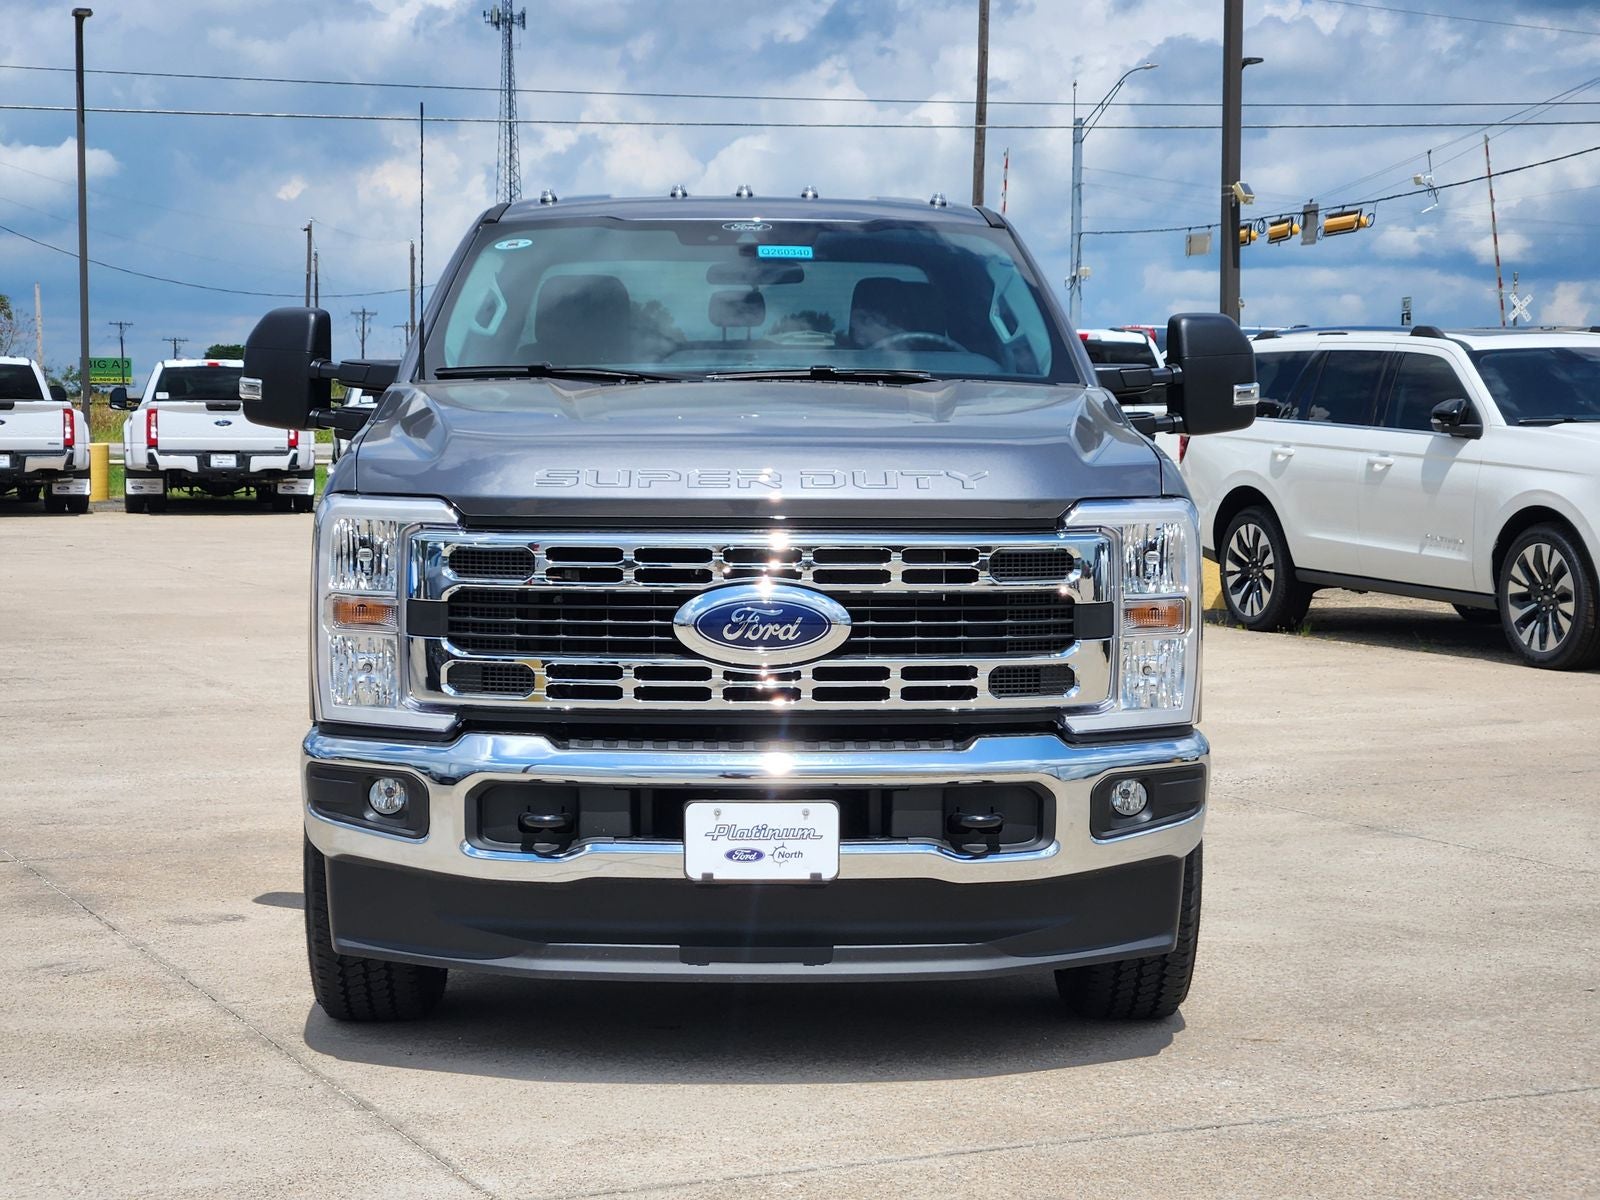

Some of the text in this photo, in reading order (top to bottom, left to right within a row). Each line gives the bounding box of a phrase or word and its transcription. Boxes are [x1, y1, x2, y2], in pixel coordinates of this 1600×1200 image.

[761, 248, 810, 256] Q260340
[534, 469, 990, 489] SUPER DUTY
[722, 607, 803, 641] Ford
[704, 824, 824, 841] Platinum
[732, 849, 758, 861] Ford
[777, 850, 804, 859] North
